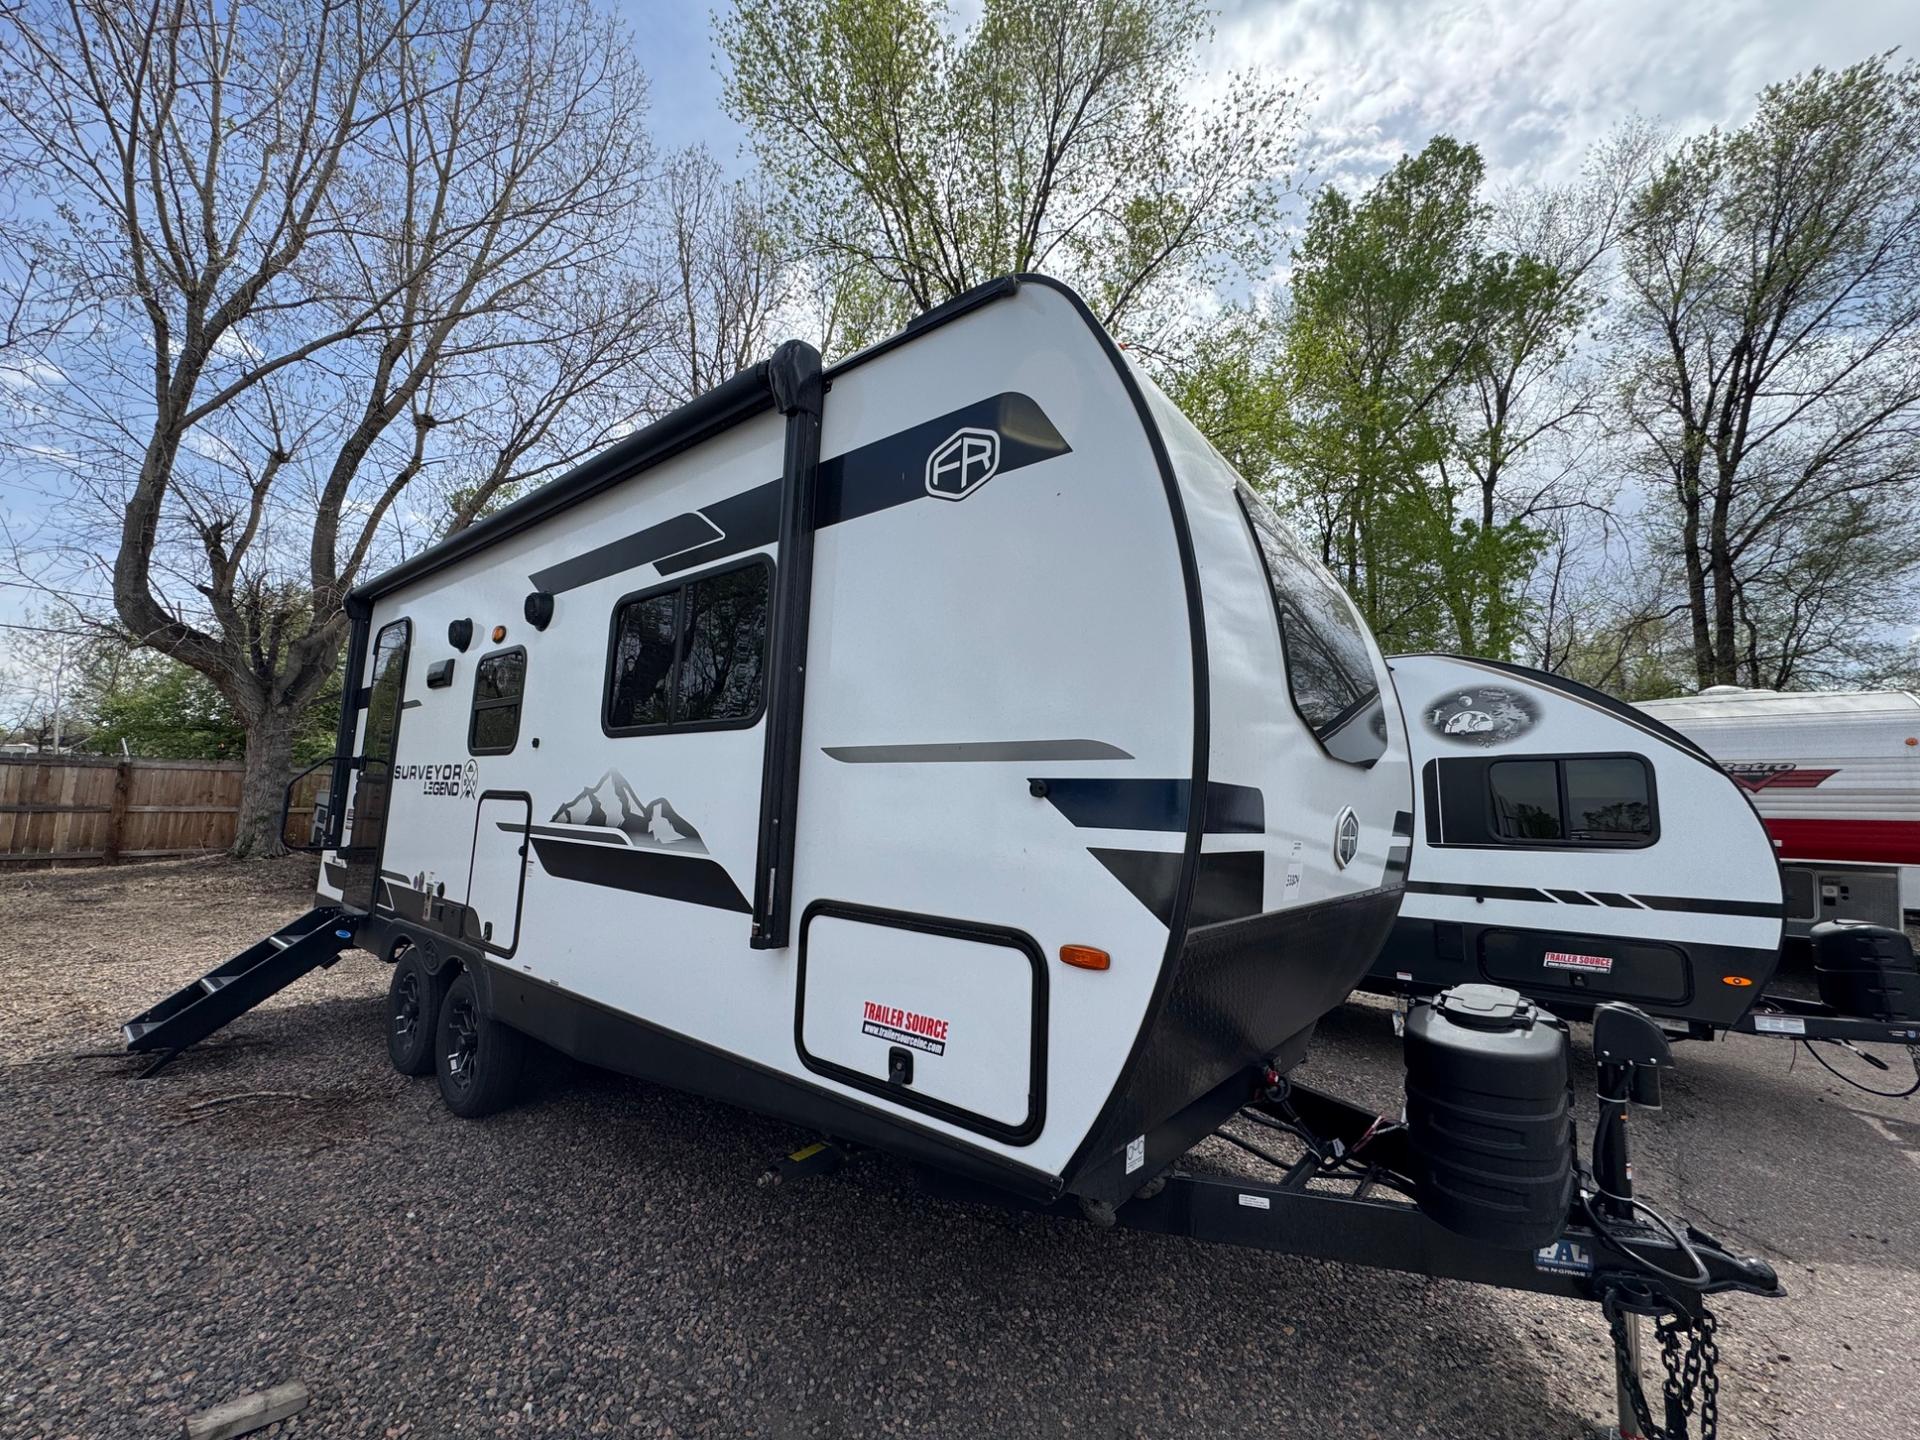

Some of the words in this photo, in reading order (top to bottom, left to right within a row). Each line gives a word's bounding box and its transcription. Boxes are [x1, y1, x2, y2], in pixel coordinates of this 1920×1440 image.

[394, 764, 462, 780] SURVEYOR
[423, 782, 460, 796] LEGEND
[1546, 953, 1578, 963] TRAILER
[1579, 956, 1610, 966] SOURCE
[864, 1001, 905, 1028] TRAILER
[905, 1011, 948, 1040] SOURCE
[863, 1023, 943, 1054] www.trailersourceinc.com
